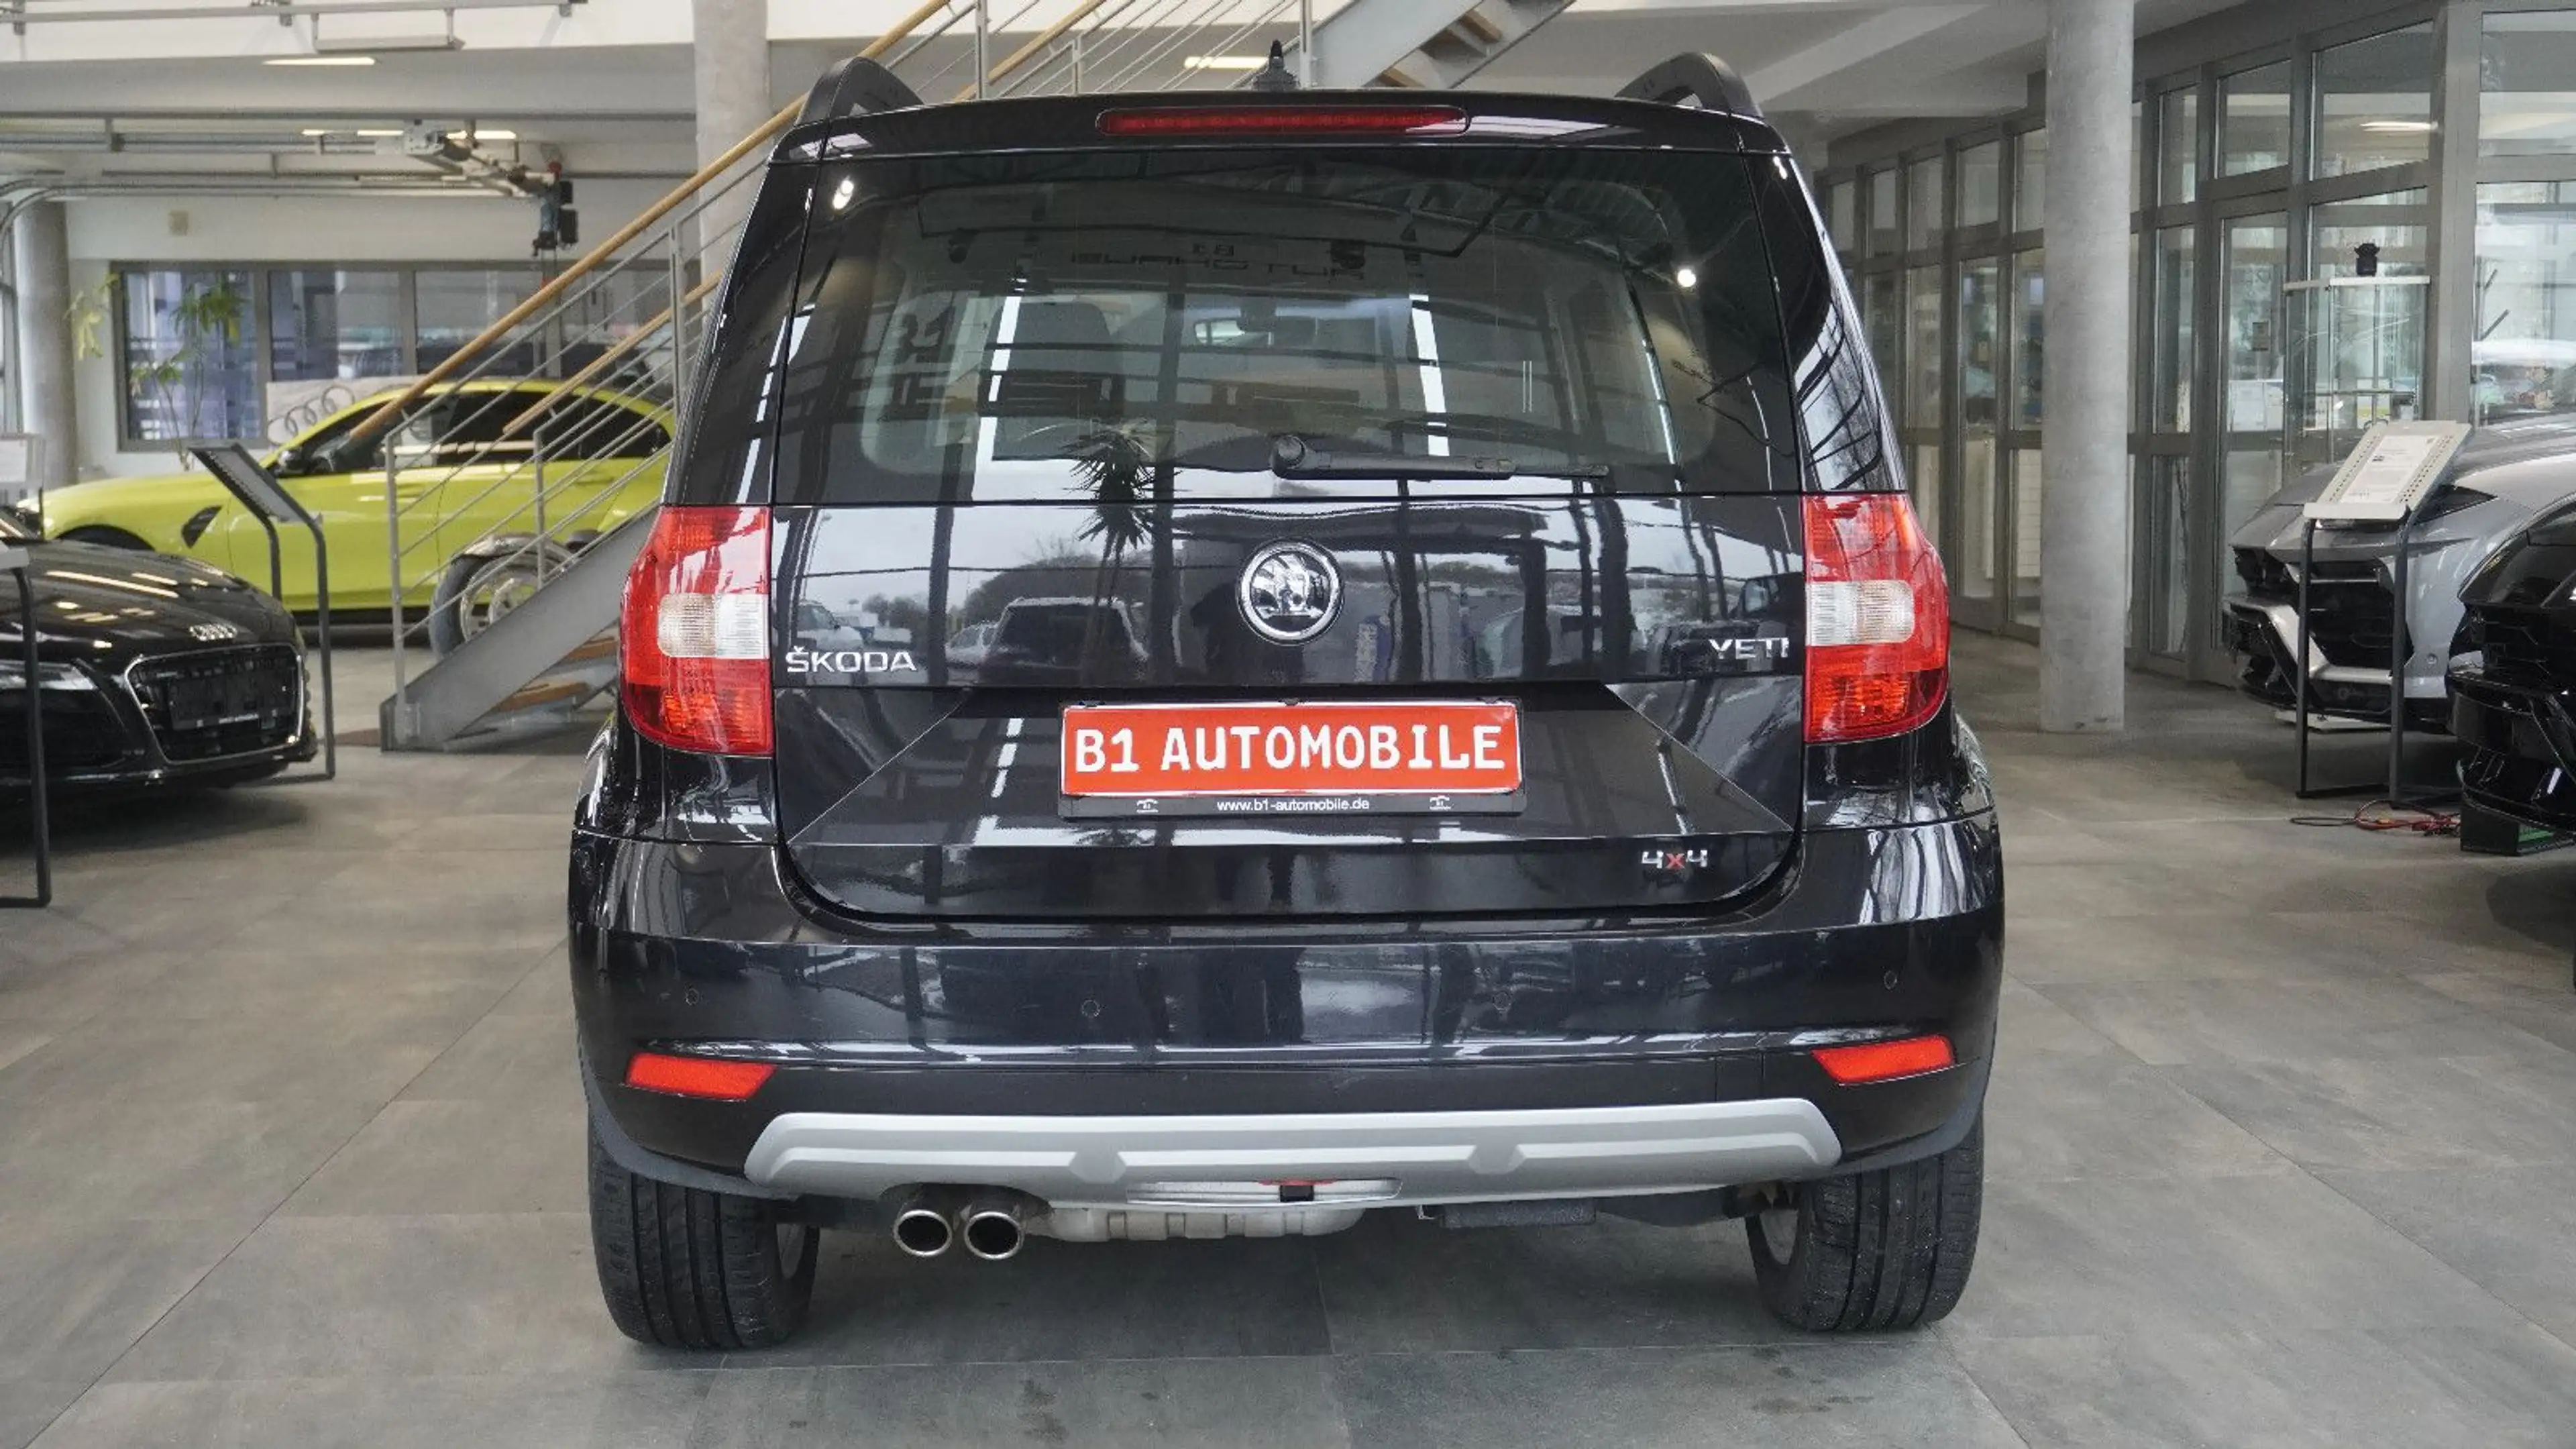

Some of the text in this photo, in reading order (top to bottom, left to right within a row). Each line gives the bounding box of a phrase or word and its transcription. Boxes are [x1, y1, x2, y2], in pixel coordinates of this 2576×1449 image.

[785, 645, 917, 673] ŠKODA
[1709, 637, 1790, 660] YETI
[1075, 724, 1505, 773] B1 AUTOMOBILE
[1216, 798, 1370, 812] www.b1-automobile.de
[1642, 849, 1708, 869] 4x4
